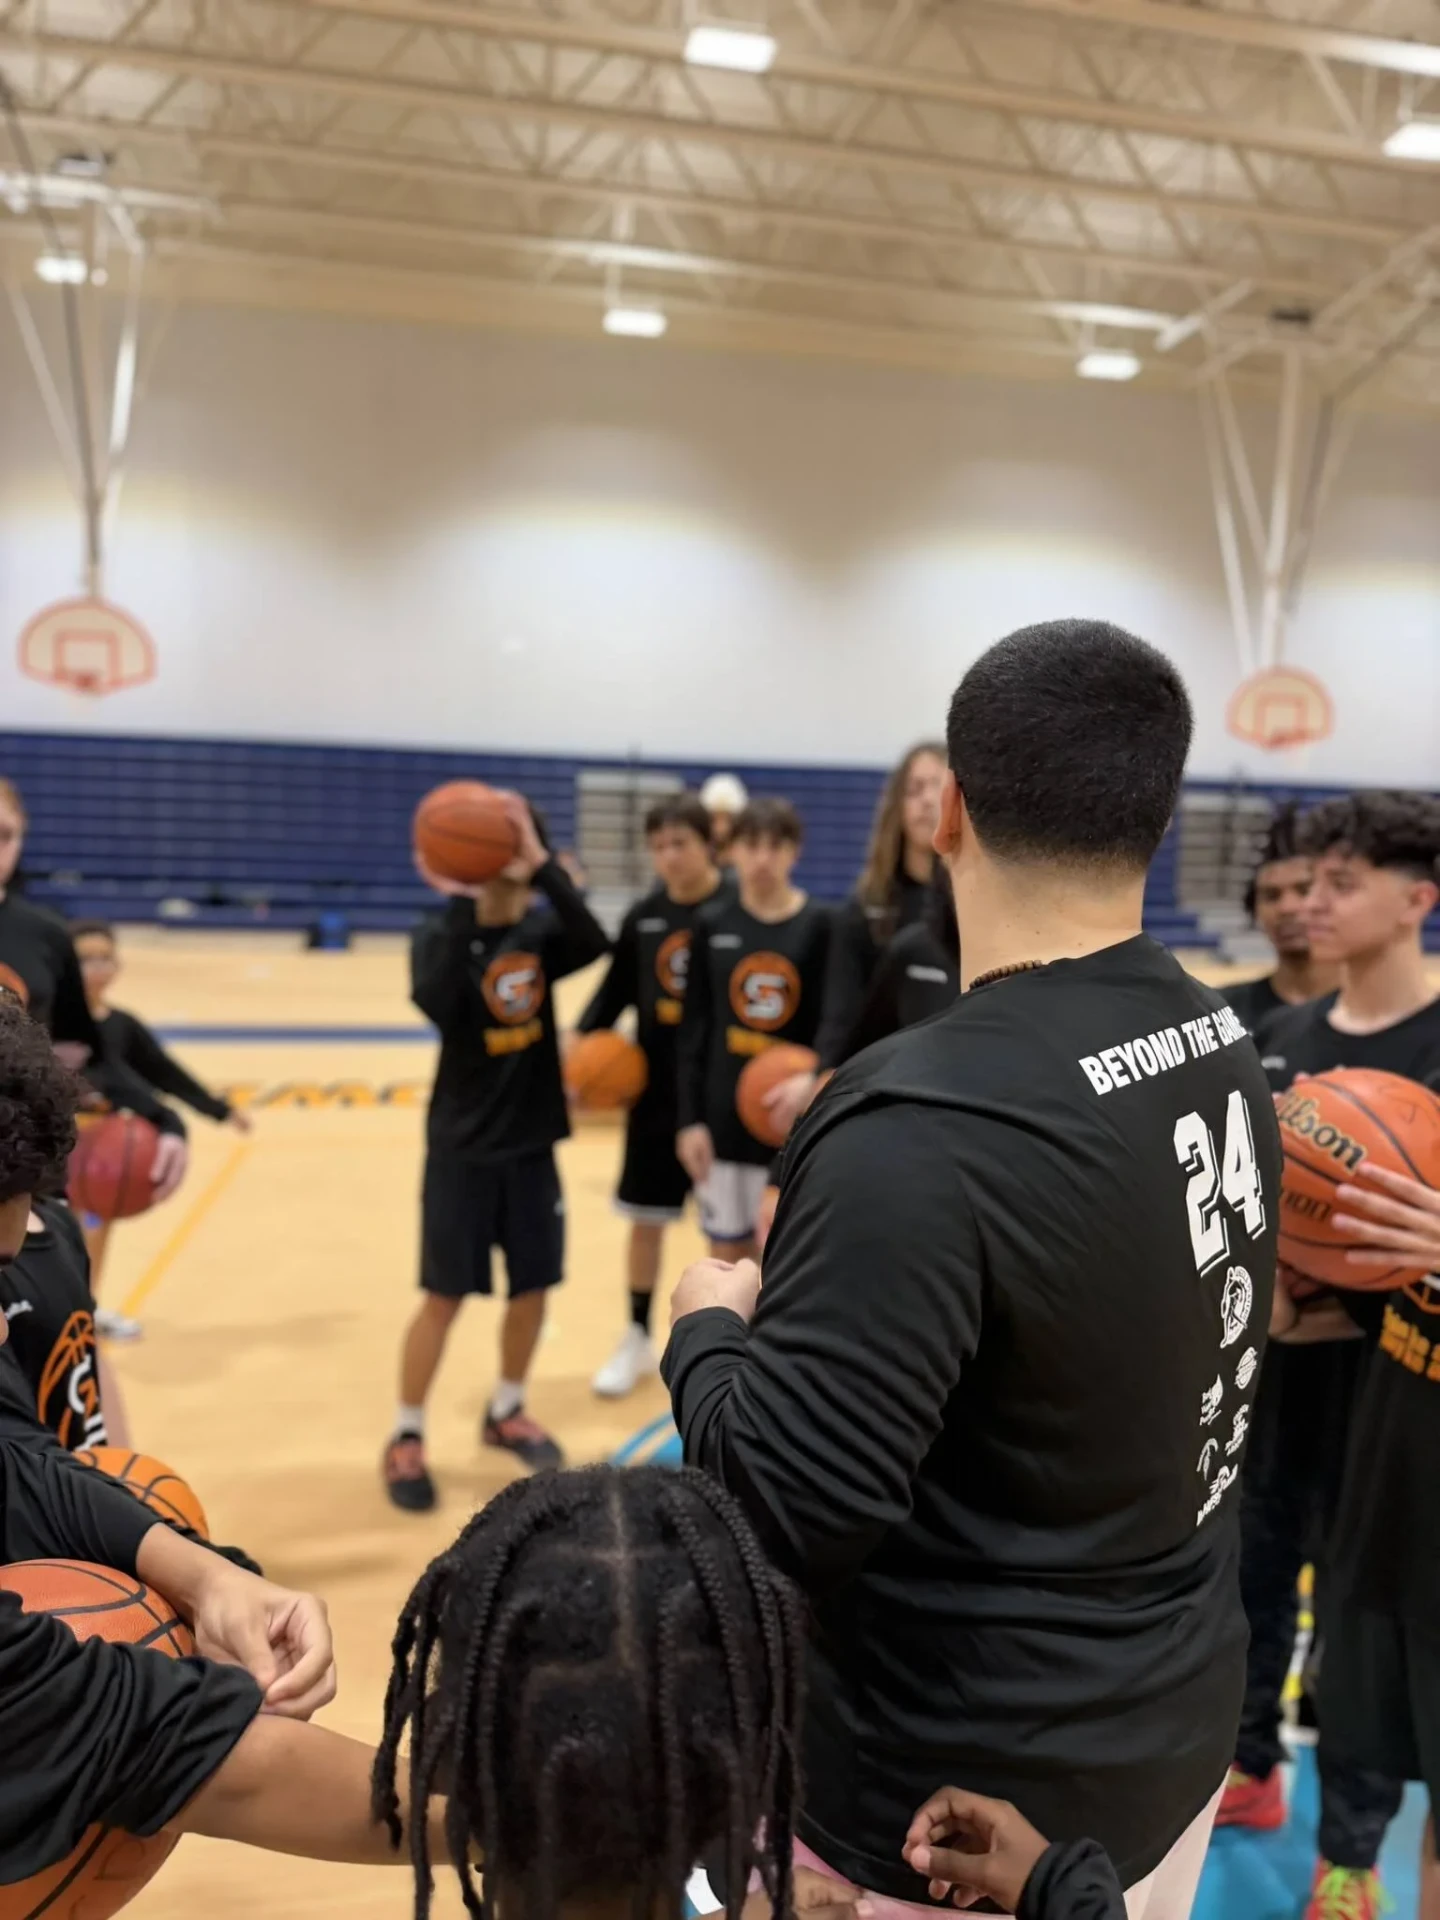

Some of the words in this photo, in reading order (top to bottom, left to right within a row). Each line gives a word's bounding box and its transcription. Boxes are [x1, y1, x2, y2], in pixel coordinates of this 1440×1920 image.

[1078, 1026, 1187, 1096] BEYOND
[1180, 1015, 1220, 1059] THE
[1173, 1089, 1267, 1278] 24
